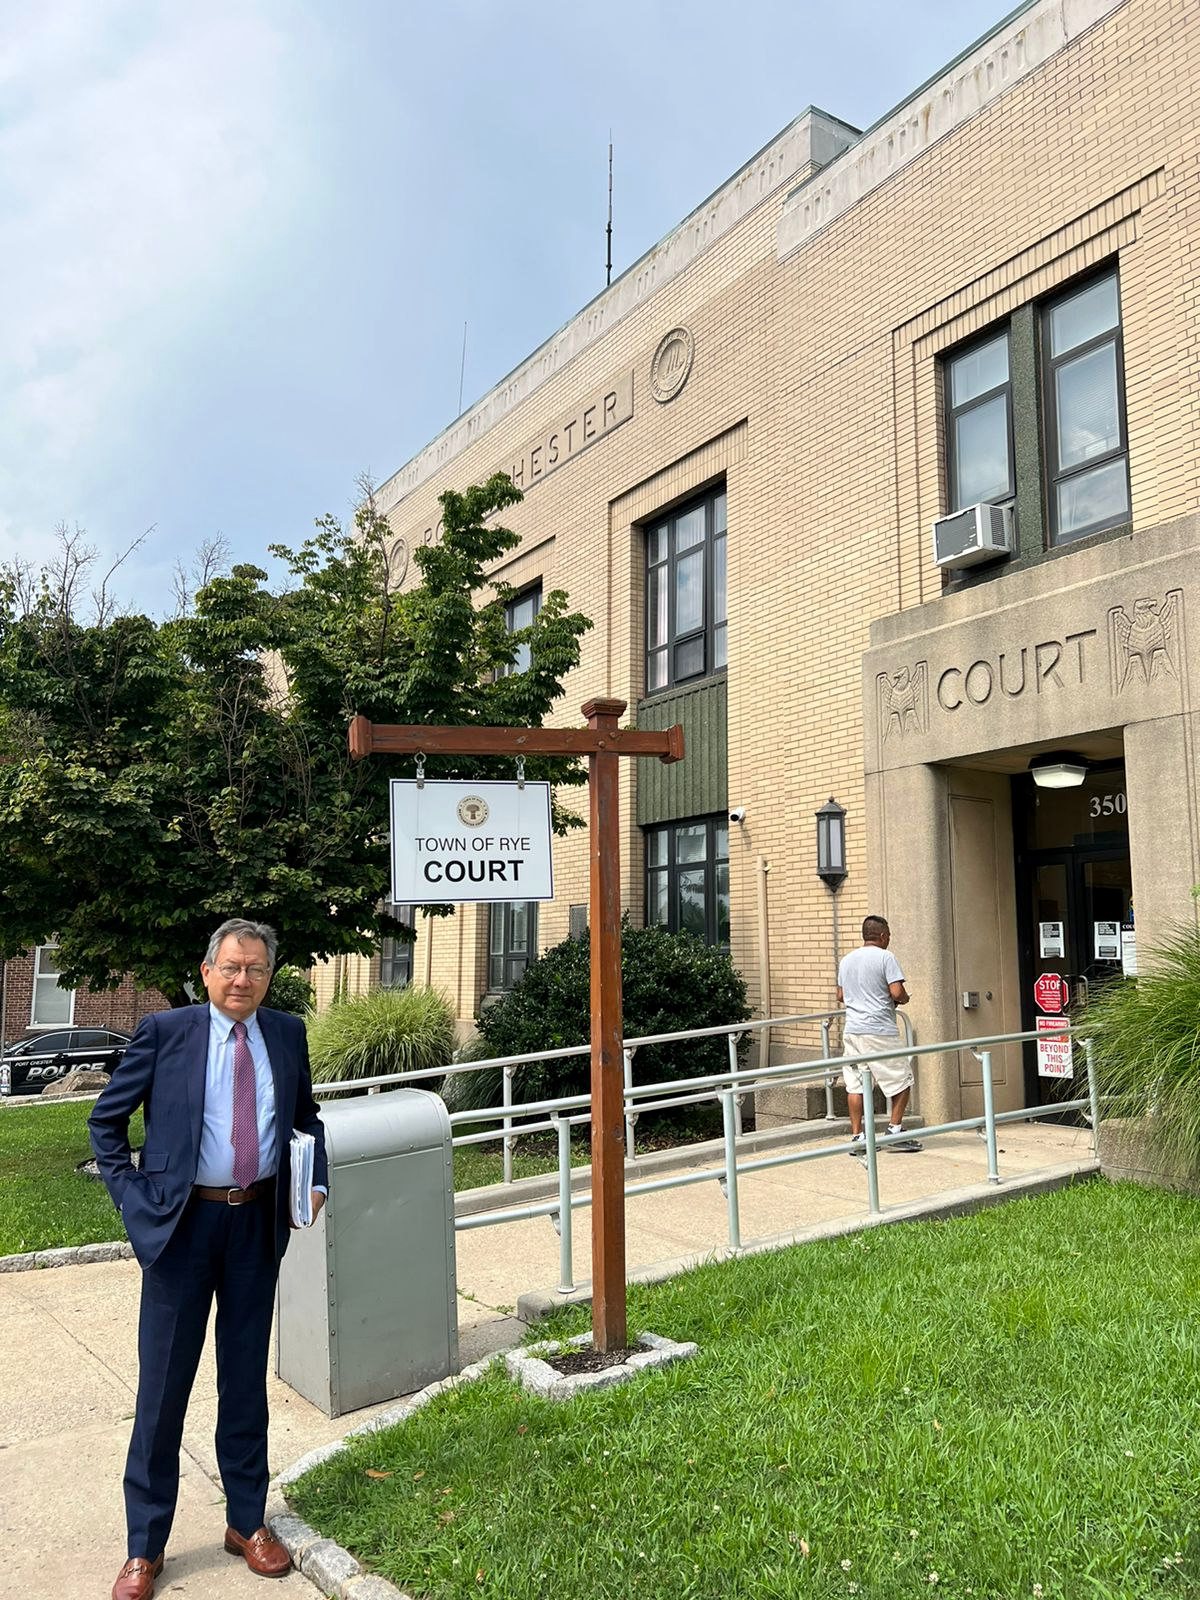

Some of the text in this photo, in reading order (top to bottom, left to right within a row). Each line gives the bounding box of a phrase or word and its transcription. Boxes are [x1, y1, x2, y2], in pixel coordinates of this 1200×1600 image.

[512, 391, 617, 486] HESTER
[937, 628, 1097, 713] COURT
[1089, 792, 1127, 818] 350
[415, 837, 531, 851] TOWN OF RYE
[424, 860, 524, 883] COURT
[1040, 1043, 1069, 1054] BEYOND
[1046, 1053, 1063, 1064] THIS
[26, 1062, 107, 1081] POLICE
[1044, 1063, 1066, 1074] POINT
